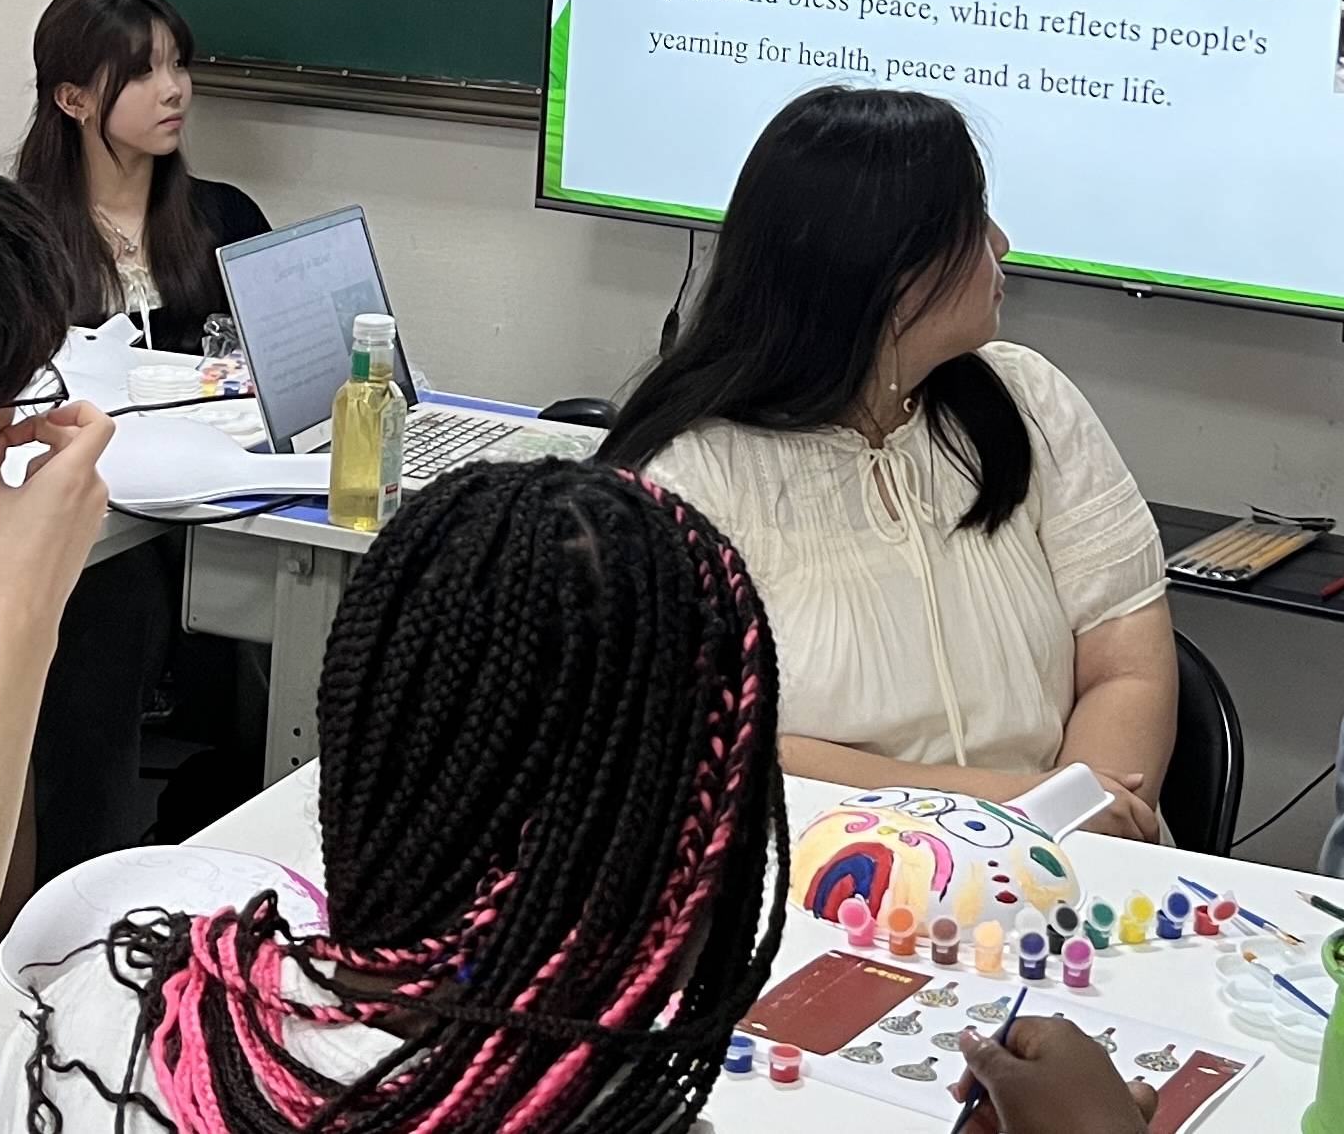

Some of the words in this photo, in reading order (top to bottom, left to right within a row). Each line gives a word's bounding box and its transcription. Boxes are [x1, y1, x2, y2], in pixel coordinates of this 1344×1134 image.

[949, 0, 1029, 31] which
[1038, 10, 1141, 42] reflects
[1150, 25, 1268, 56] people's
[648, 31, 749, 65] yearning
[756, 37, 792, 63] for
[797, 41, 877, 78] health,
[885, 58, 956, 82] peace
[963, 63, 1009, 88] and
[1017, 73, 1031, 90] a
[1040, 67, 1115, 100] better
[1121, 76, 1172, 107] life.
